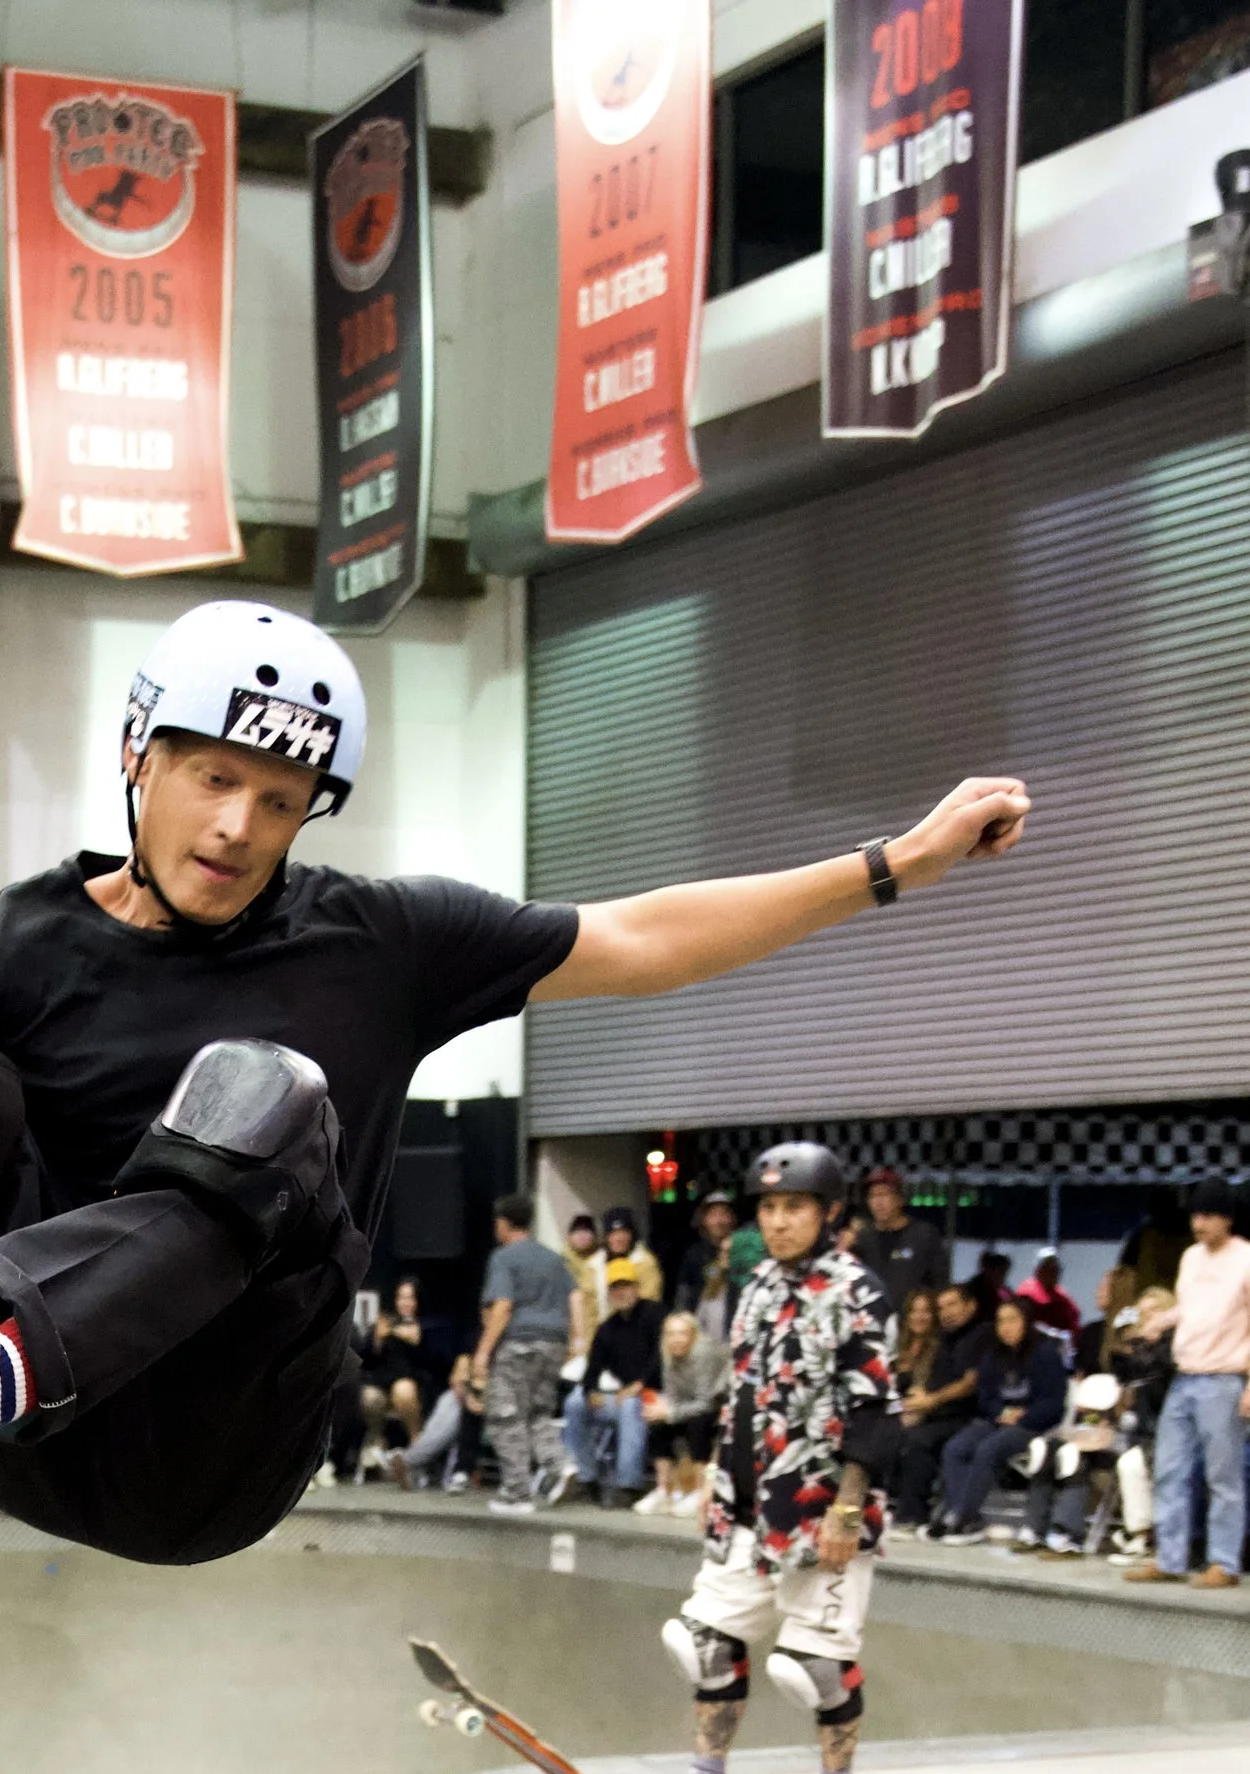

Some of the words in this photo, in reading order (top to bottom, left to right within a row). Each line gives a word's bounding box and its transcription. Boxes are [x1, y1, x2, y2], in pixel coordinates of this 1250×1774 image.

[70, 263, 174, 328] 2005
[226, 702, 336, 768] ムラサキ
